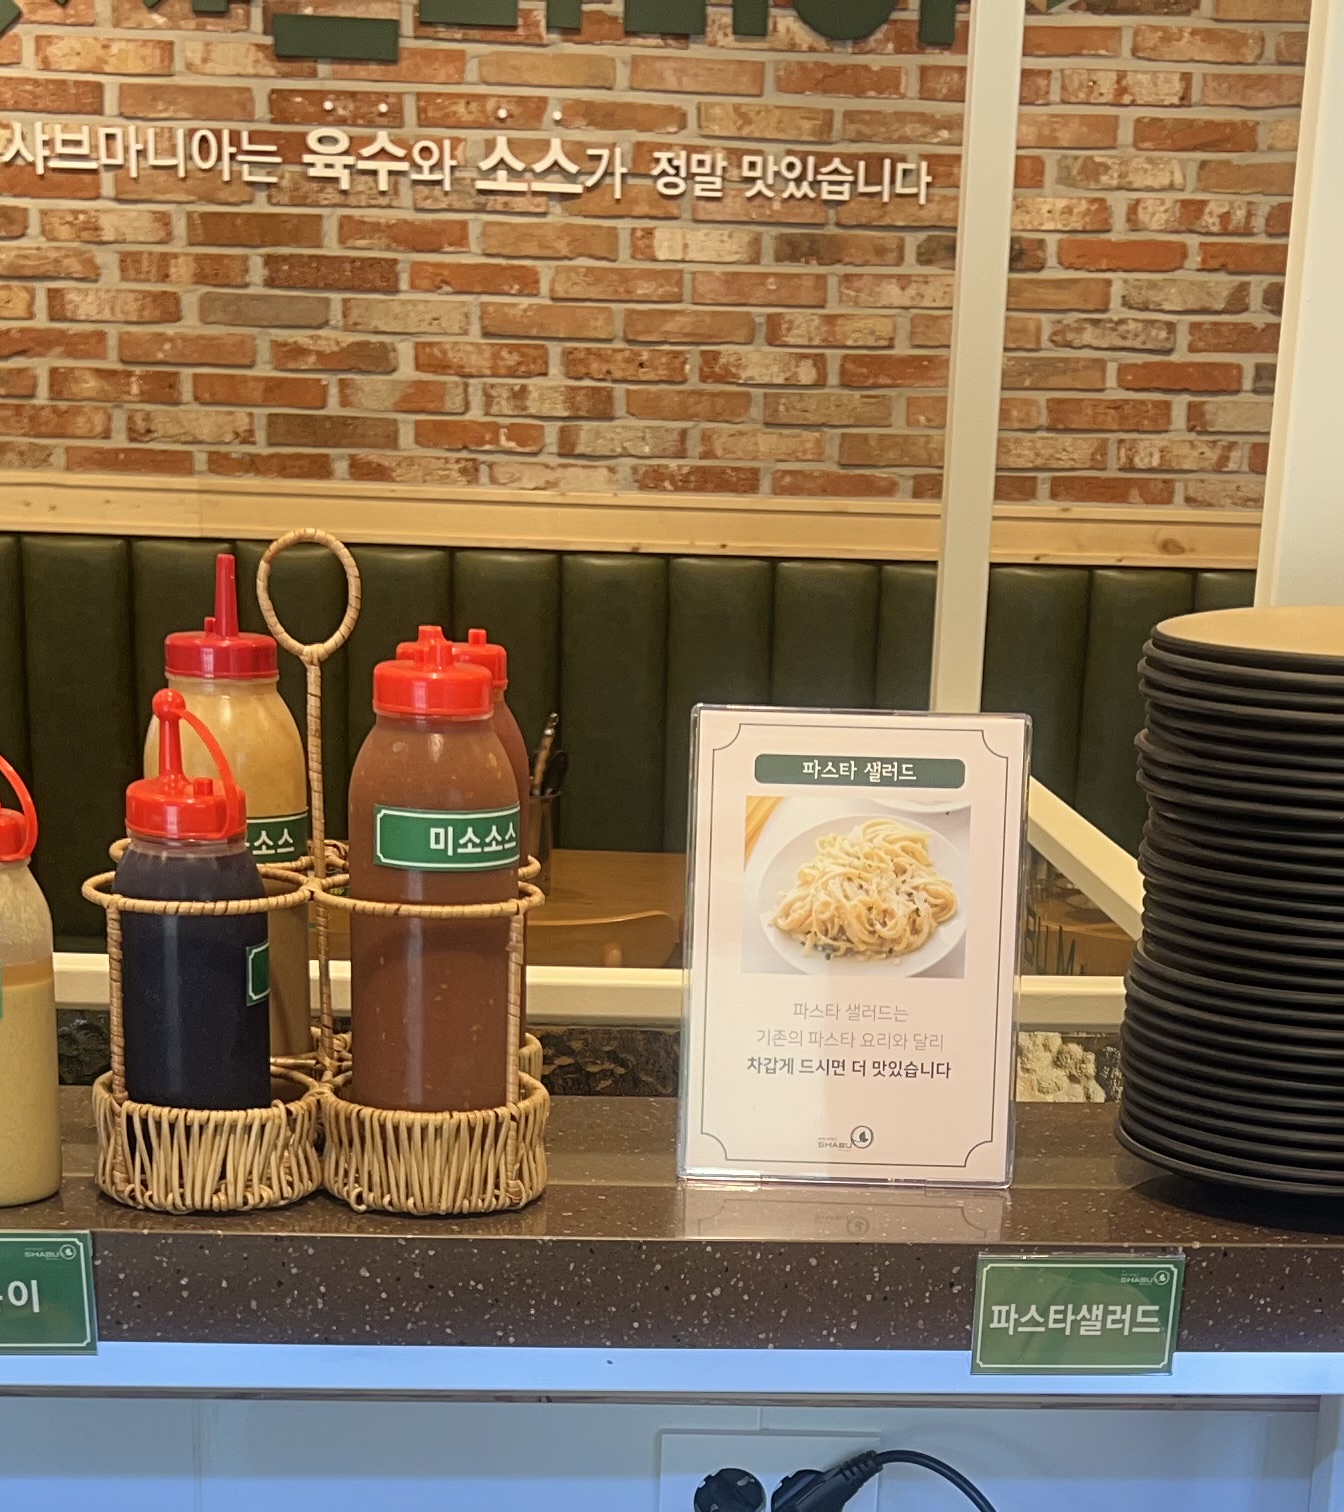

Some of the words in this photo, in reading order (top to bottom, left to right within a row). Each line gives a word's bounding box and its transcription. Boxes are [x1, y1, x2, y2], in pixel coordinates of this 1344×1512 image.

[1, 120, 283, 184] 샤브마니아는
[301, 126, 458, 193] 육수와
[474, 135, 629, 200] 소스가
[650, 149, 728, 199] 정말
[741, 154, 933, 205] 맛있습니다
[802, 759, 858, 780] 파스타
[864, 761, 917, 782] 샐러드
[244, 828, 296, 855] 소스
[429, 822, 517, 857] 미소소스
[792, 1002, 841, 1020] 파스타
[845, 1003, 909, 1023] 샐러드는
[756, 1029, 804, 1047] 기존의
[807, 1030, 856, 1049] 파스타
[860, 1032, 908, 1050] 요리와
[913, 1033, 944, 1051] 달리
[746, 1056, 794, 1076] 차갑게
[798, 1058, 846, 1077] 드시면
[852, 1059, 867, 1077] 더
[871, 1060, 952, 1079] 맛있습니다
[989, 1303, 1161, 1336] 파스타샐러드
